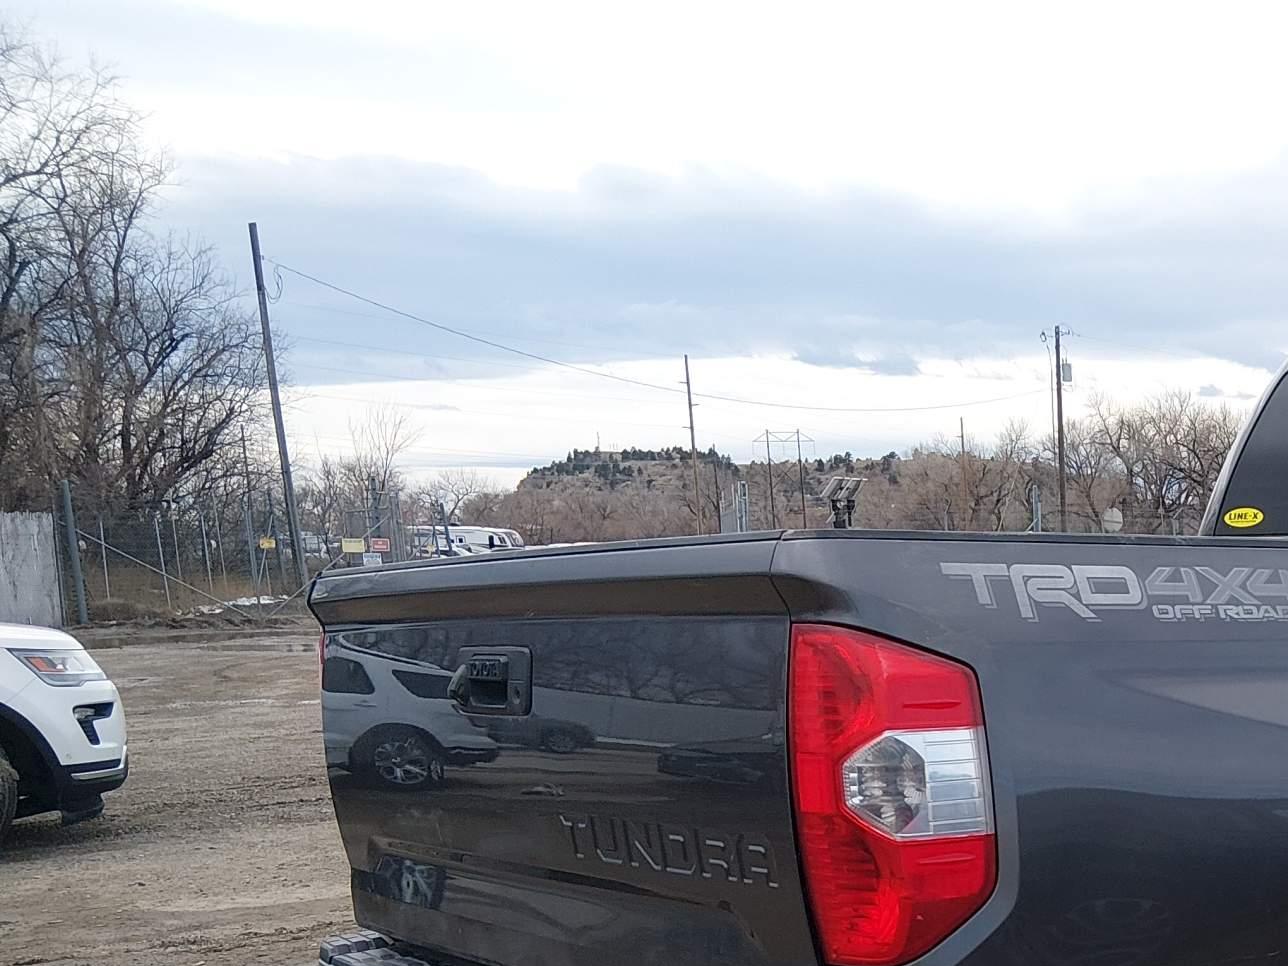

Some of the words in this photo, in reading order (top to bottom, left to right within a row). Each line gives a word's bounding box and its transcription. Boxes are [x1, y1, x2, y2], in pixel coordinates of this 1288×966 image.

[1228, 511, 1259, 521] LINE-X
[939, 562, 1148, 623] TRD
[1151, 603, 1215, 622] OFF
[559, 813, 780, 889] TUNDRA
